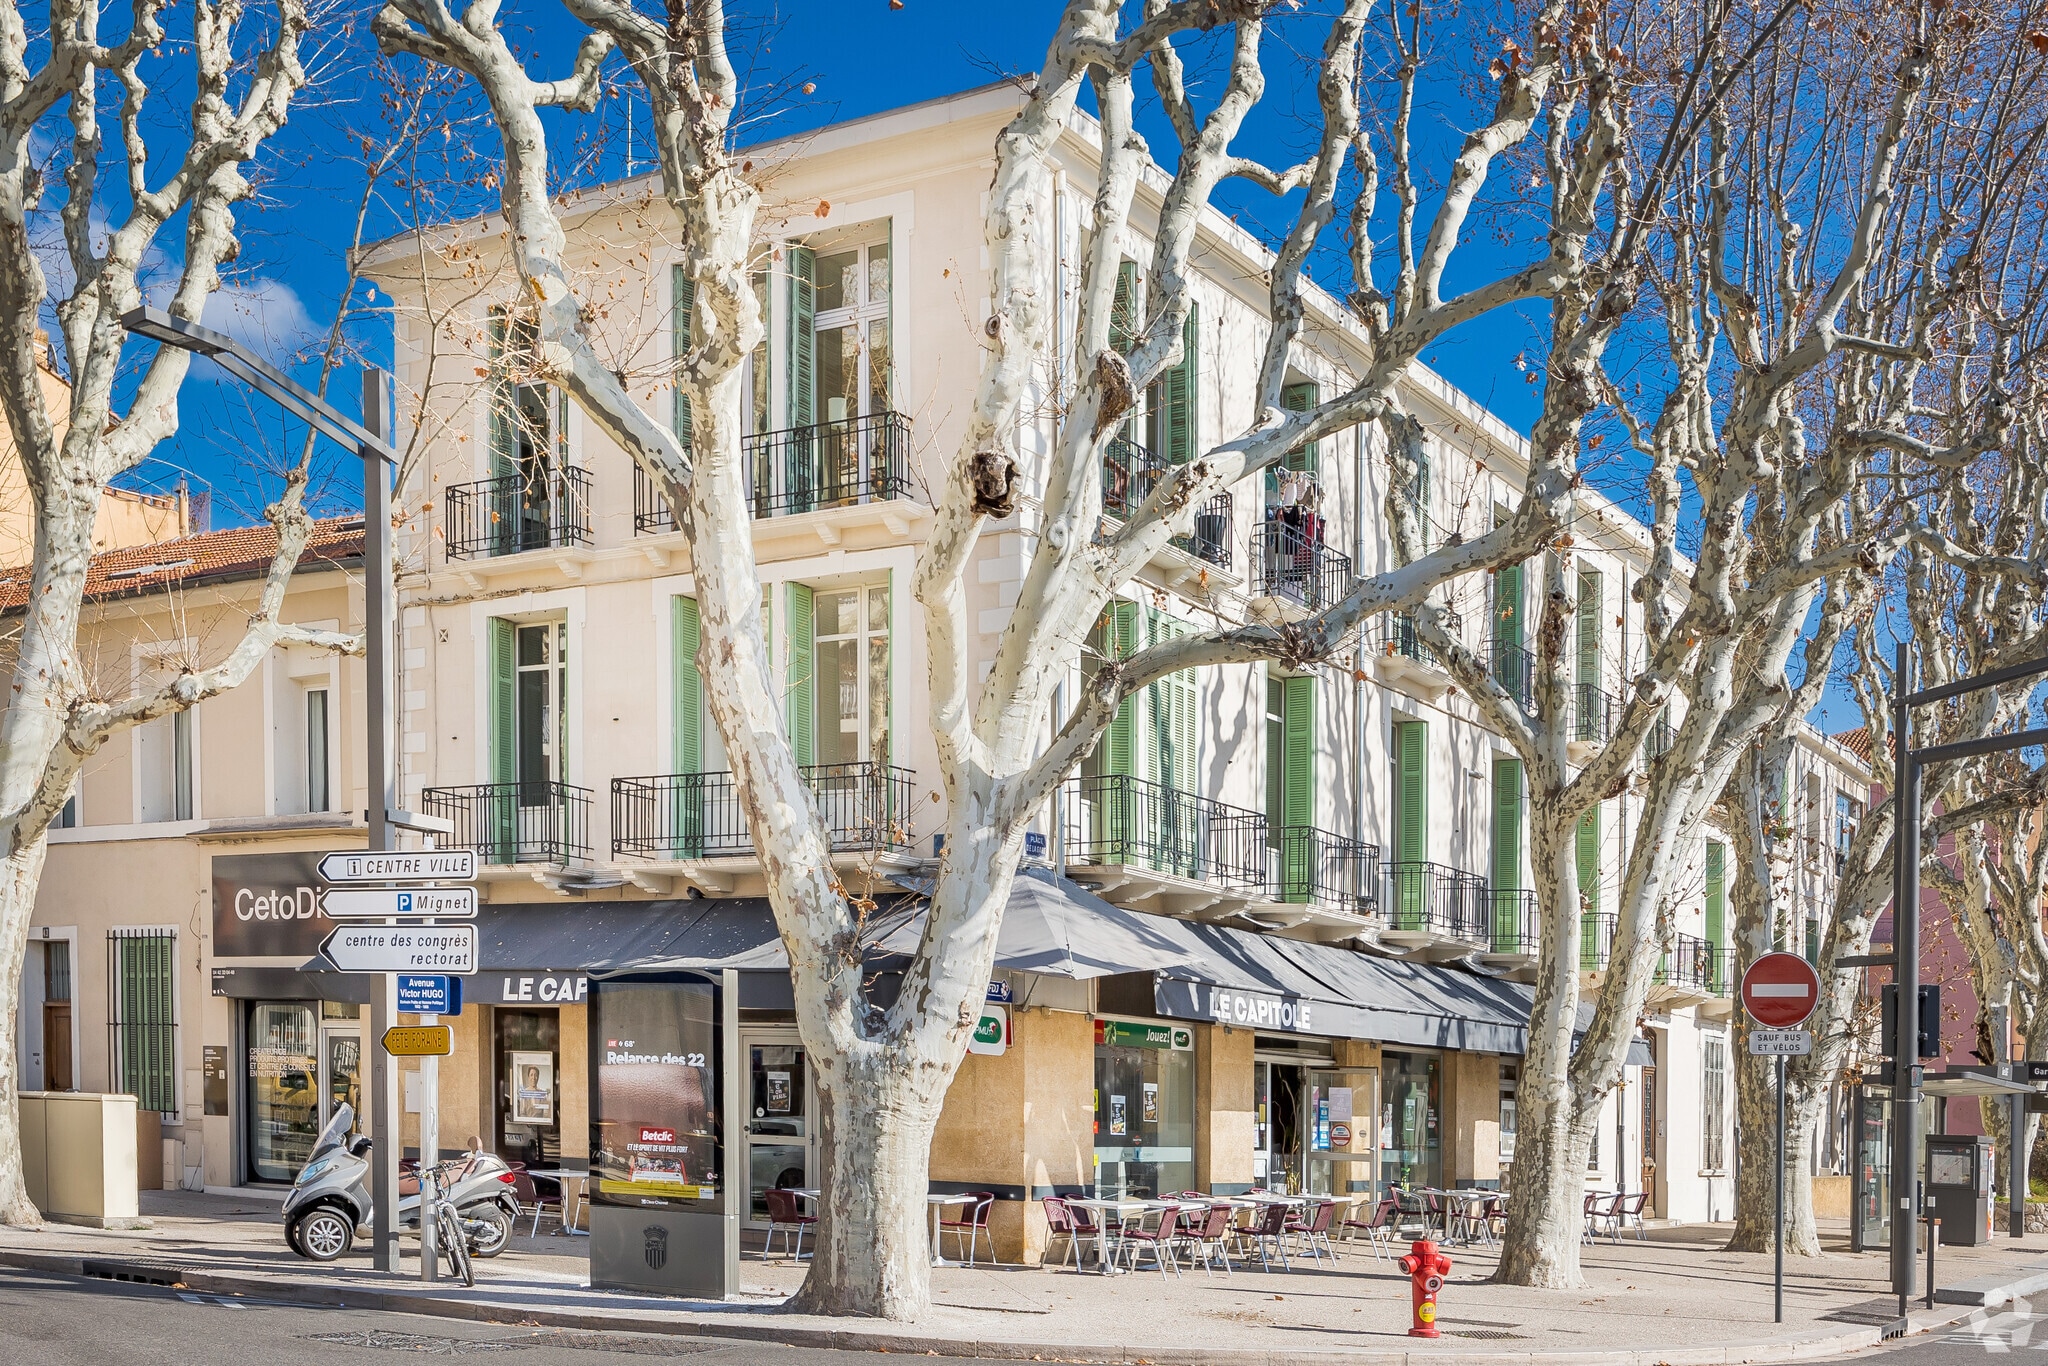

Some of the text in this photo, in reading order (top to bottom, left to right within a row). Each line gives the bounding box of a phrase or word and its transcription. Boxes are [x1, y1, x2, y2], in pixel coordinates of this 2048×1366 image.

[366, 859, 421, 874] CENTRE
[430, 857, 468, 872] VILLE
[416, 895, 468, 913] Mignet
[345, 934, 468, 950] centre des congrès
[410, 952, 468, 966] rectorat
[408, 978, 435, 988] Avenue
[502, 977, 587, 1001] LE CAP
[988, 983, 999, 994] FDJ
[399, 988, 444, 999] Victor HUGO
[1209, 992, 1311, 1030] LE CAPITOLE
[975, 1026, 989, 1036] PMU
[1146, 1028, 1171, 1044] Jouez!
[1757, 1034, 1801, 1042] SAUF BUS
[392, 1031, 442, 1049] FETE FORAINE
[249, 1062, 257, 1070] ET
[607, 1051, 705, 1067] Relance des 22
[642, 1130, 673, 1141] Betclic
[626, 1143, 633, 1151] ET
[633, 1143, 639, 1151] LE
[639, 1144, 652, 1152] SPORT
[652, 1144, 659, 1152] SE
